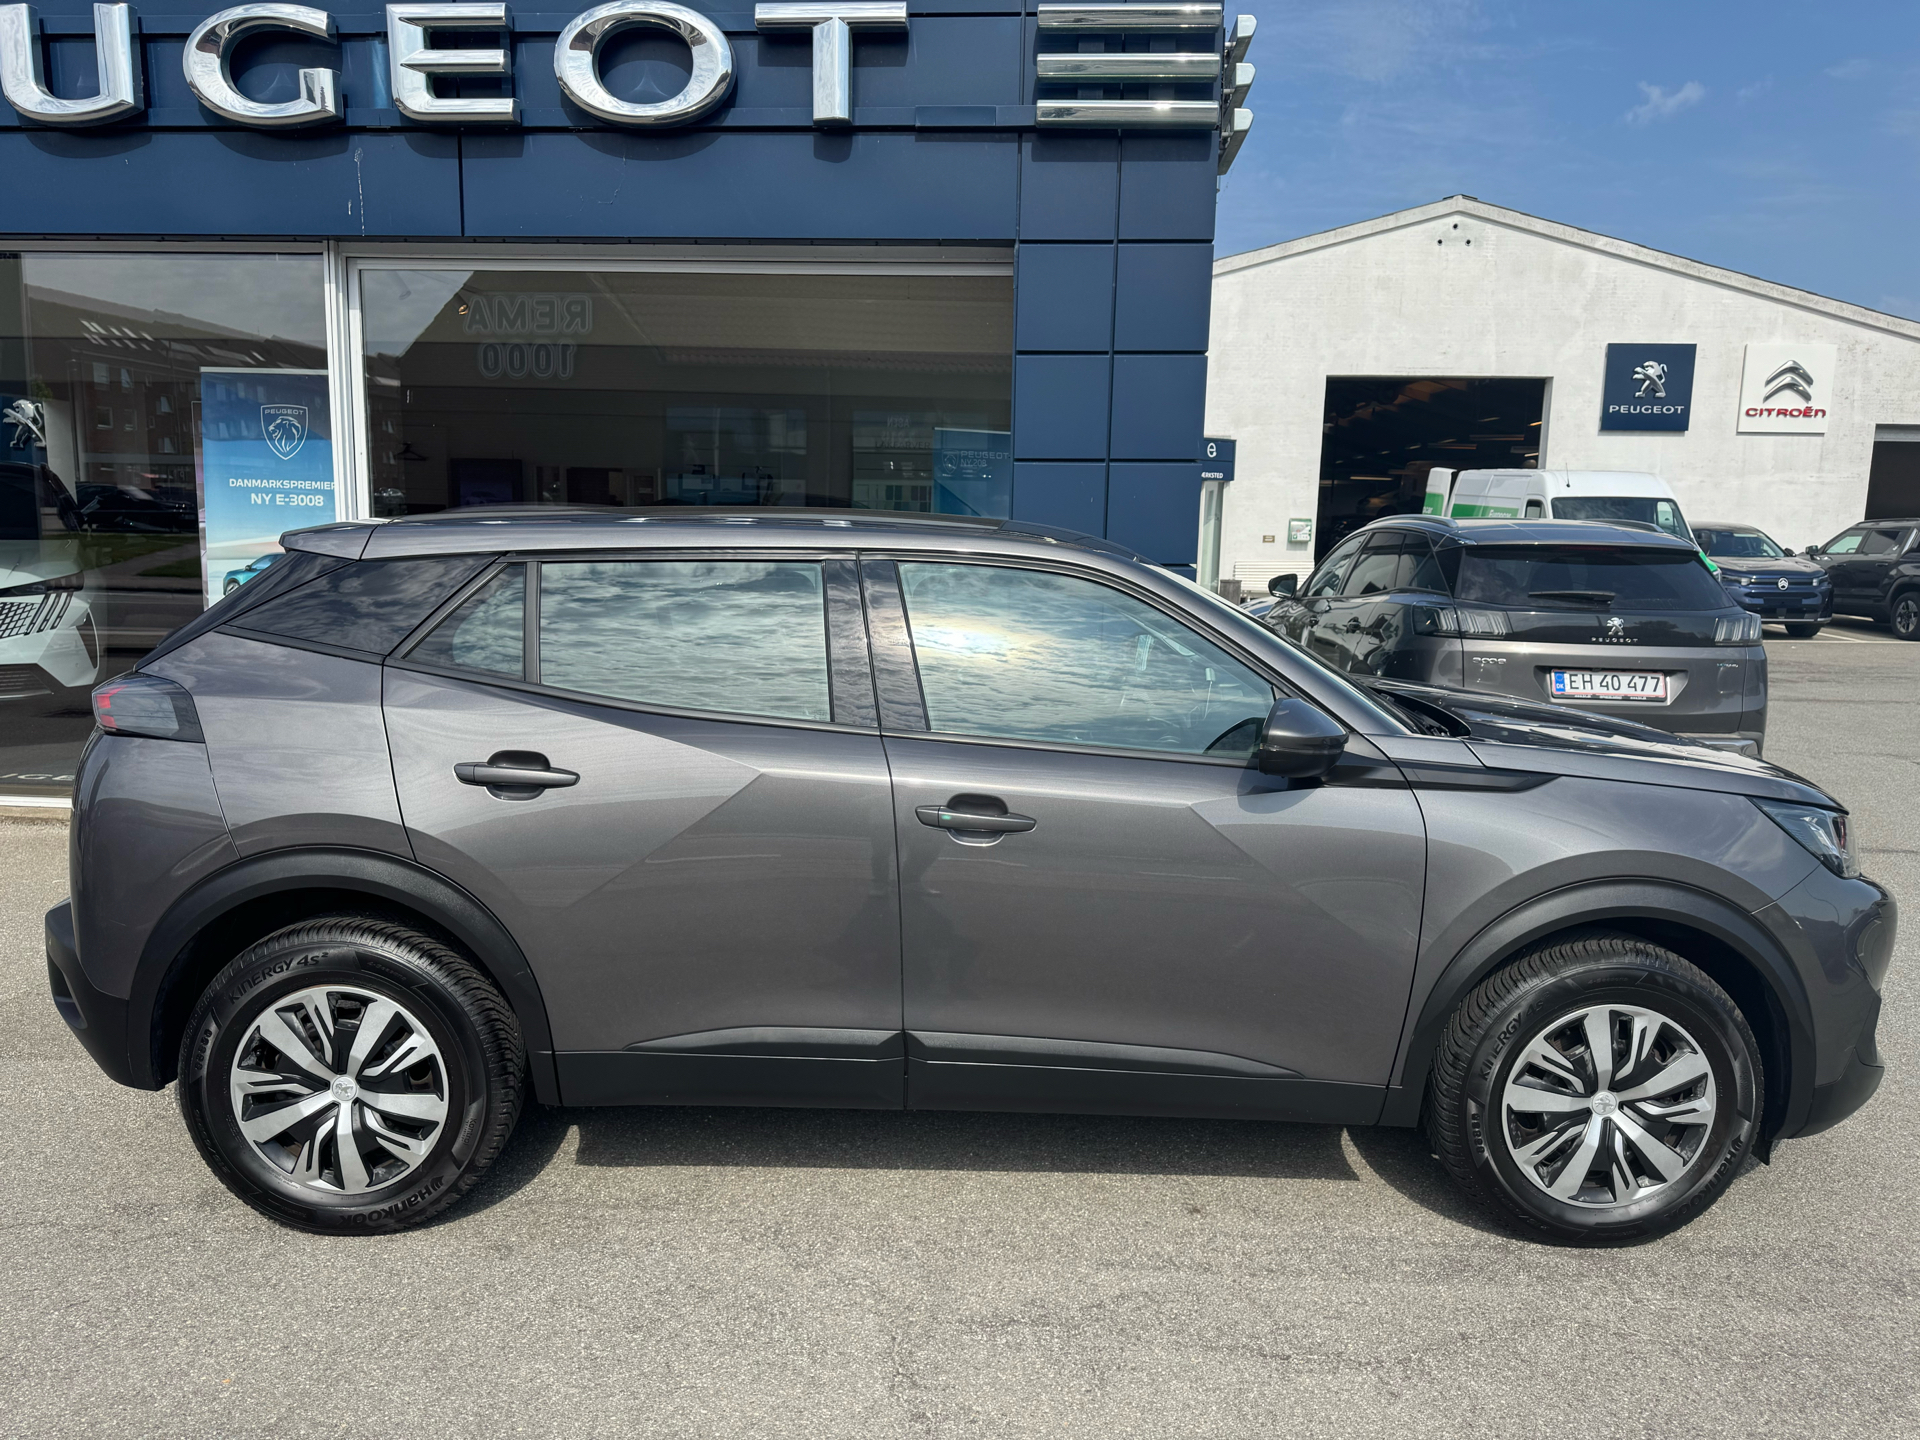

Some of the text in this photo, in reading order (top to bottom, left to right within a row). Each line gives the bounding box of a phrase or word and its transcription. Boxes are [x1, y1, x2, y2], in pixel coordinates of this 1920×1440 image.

[0, 1, 909, 127] UGEOT
[1609, 404, 1685, 414] PEUGEOT
[1745, 406, 1826, 418] CITROËN
[960, 450, 1009, 460] PEUGEOT
[251, 493, 324, 506] NY E-3008
[1569, 674, 1660, 692] EH 40 477
[228, 957, 294, 1005] KINERGY
